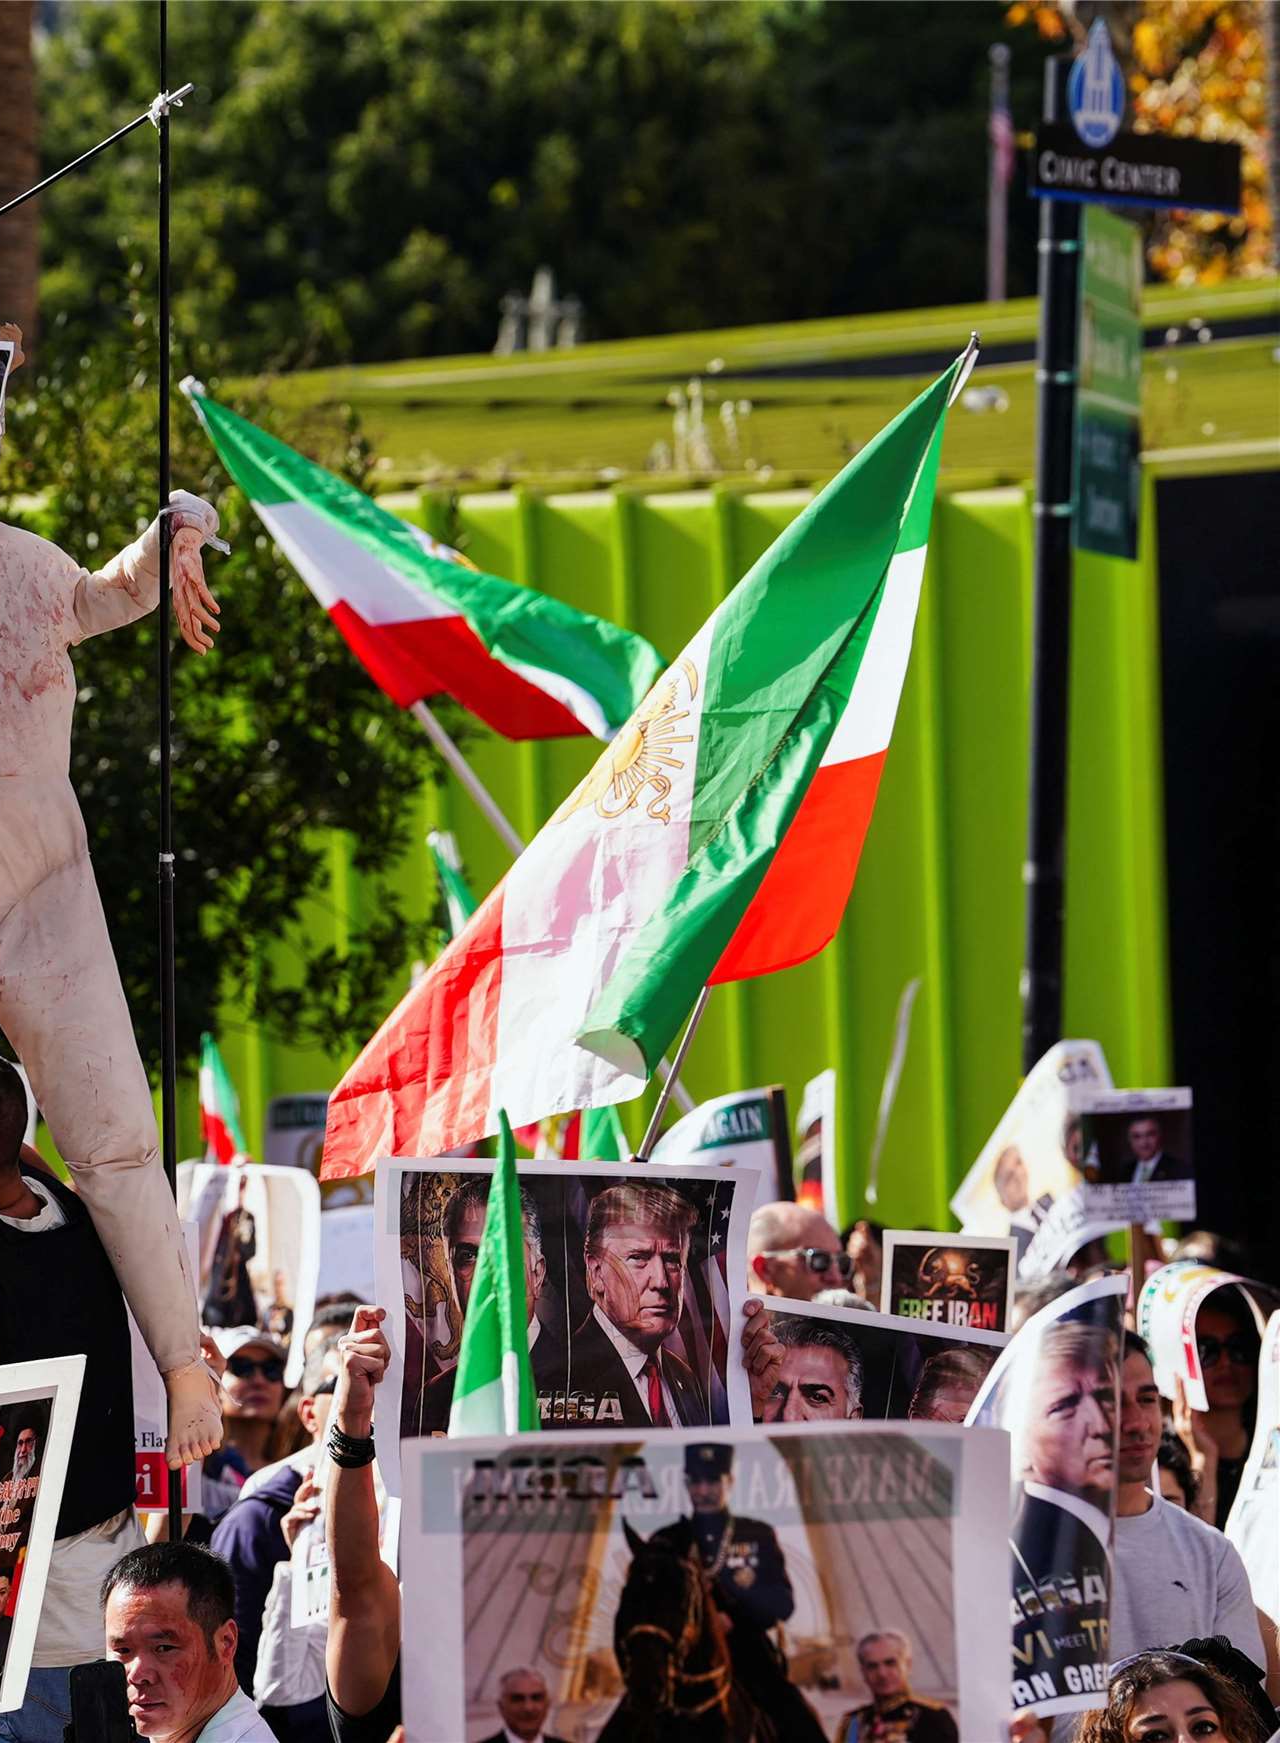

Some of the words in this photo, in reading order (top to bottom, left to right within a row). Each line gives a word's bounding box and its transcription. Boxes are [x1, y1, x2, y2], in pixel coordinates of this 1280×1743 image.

[1038, 150, 1096, 189] CIVIC
[1101, 156, 1181, 195] CENTER
[704, 1105, 763, 1144] AGAIN
[899, 1299, 944, 1321] FREE
[948, 1300, 997, 1328] IRAN
[141, 1432, 164, 1448] Fla
[1054, 1633, 1087, 1649] MEET
[1011, 1671, 1057, 1706] AN
